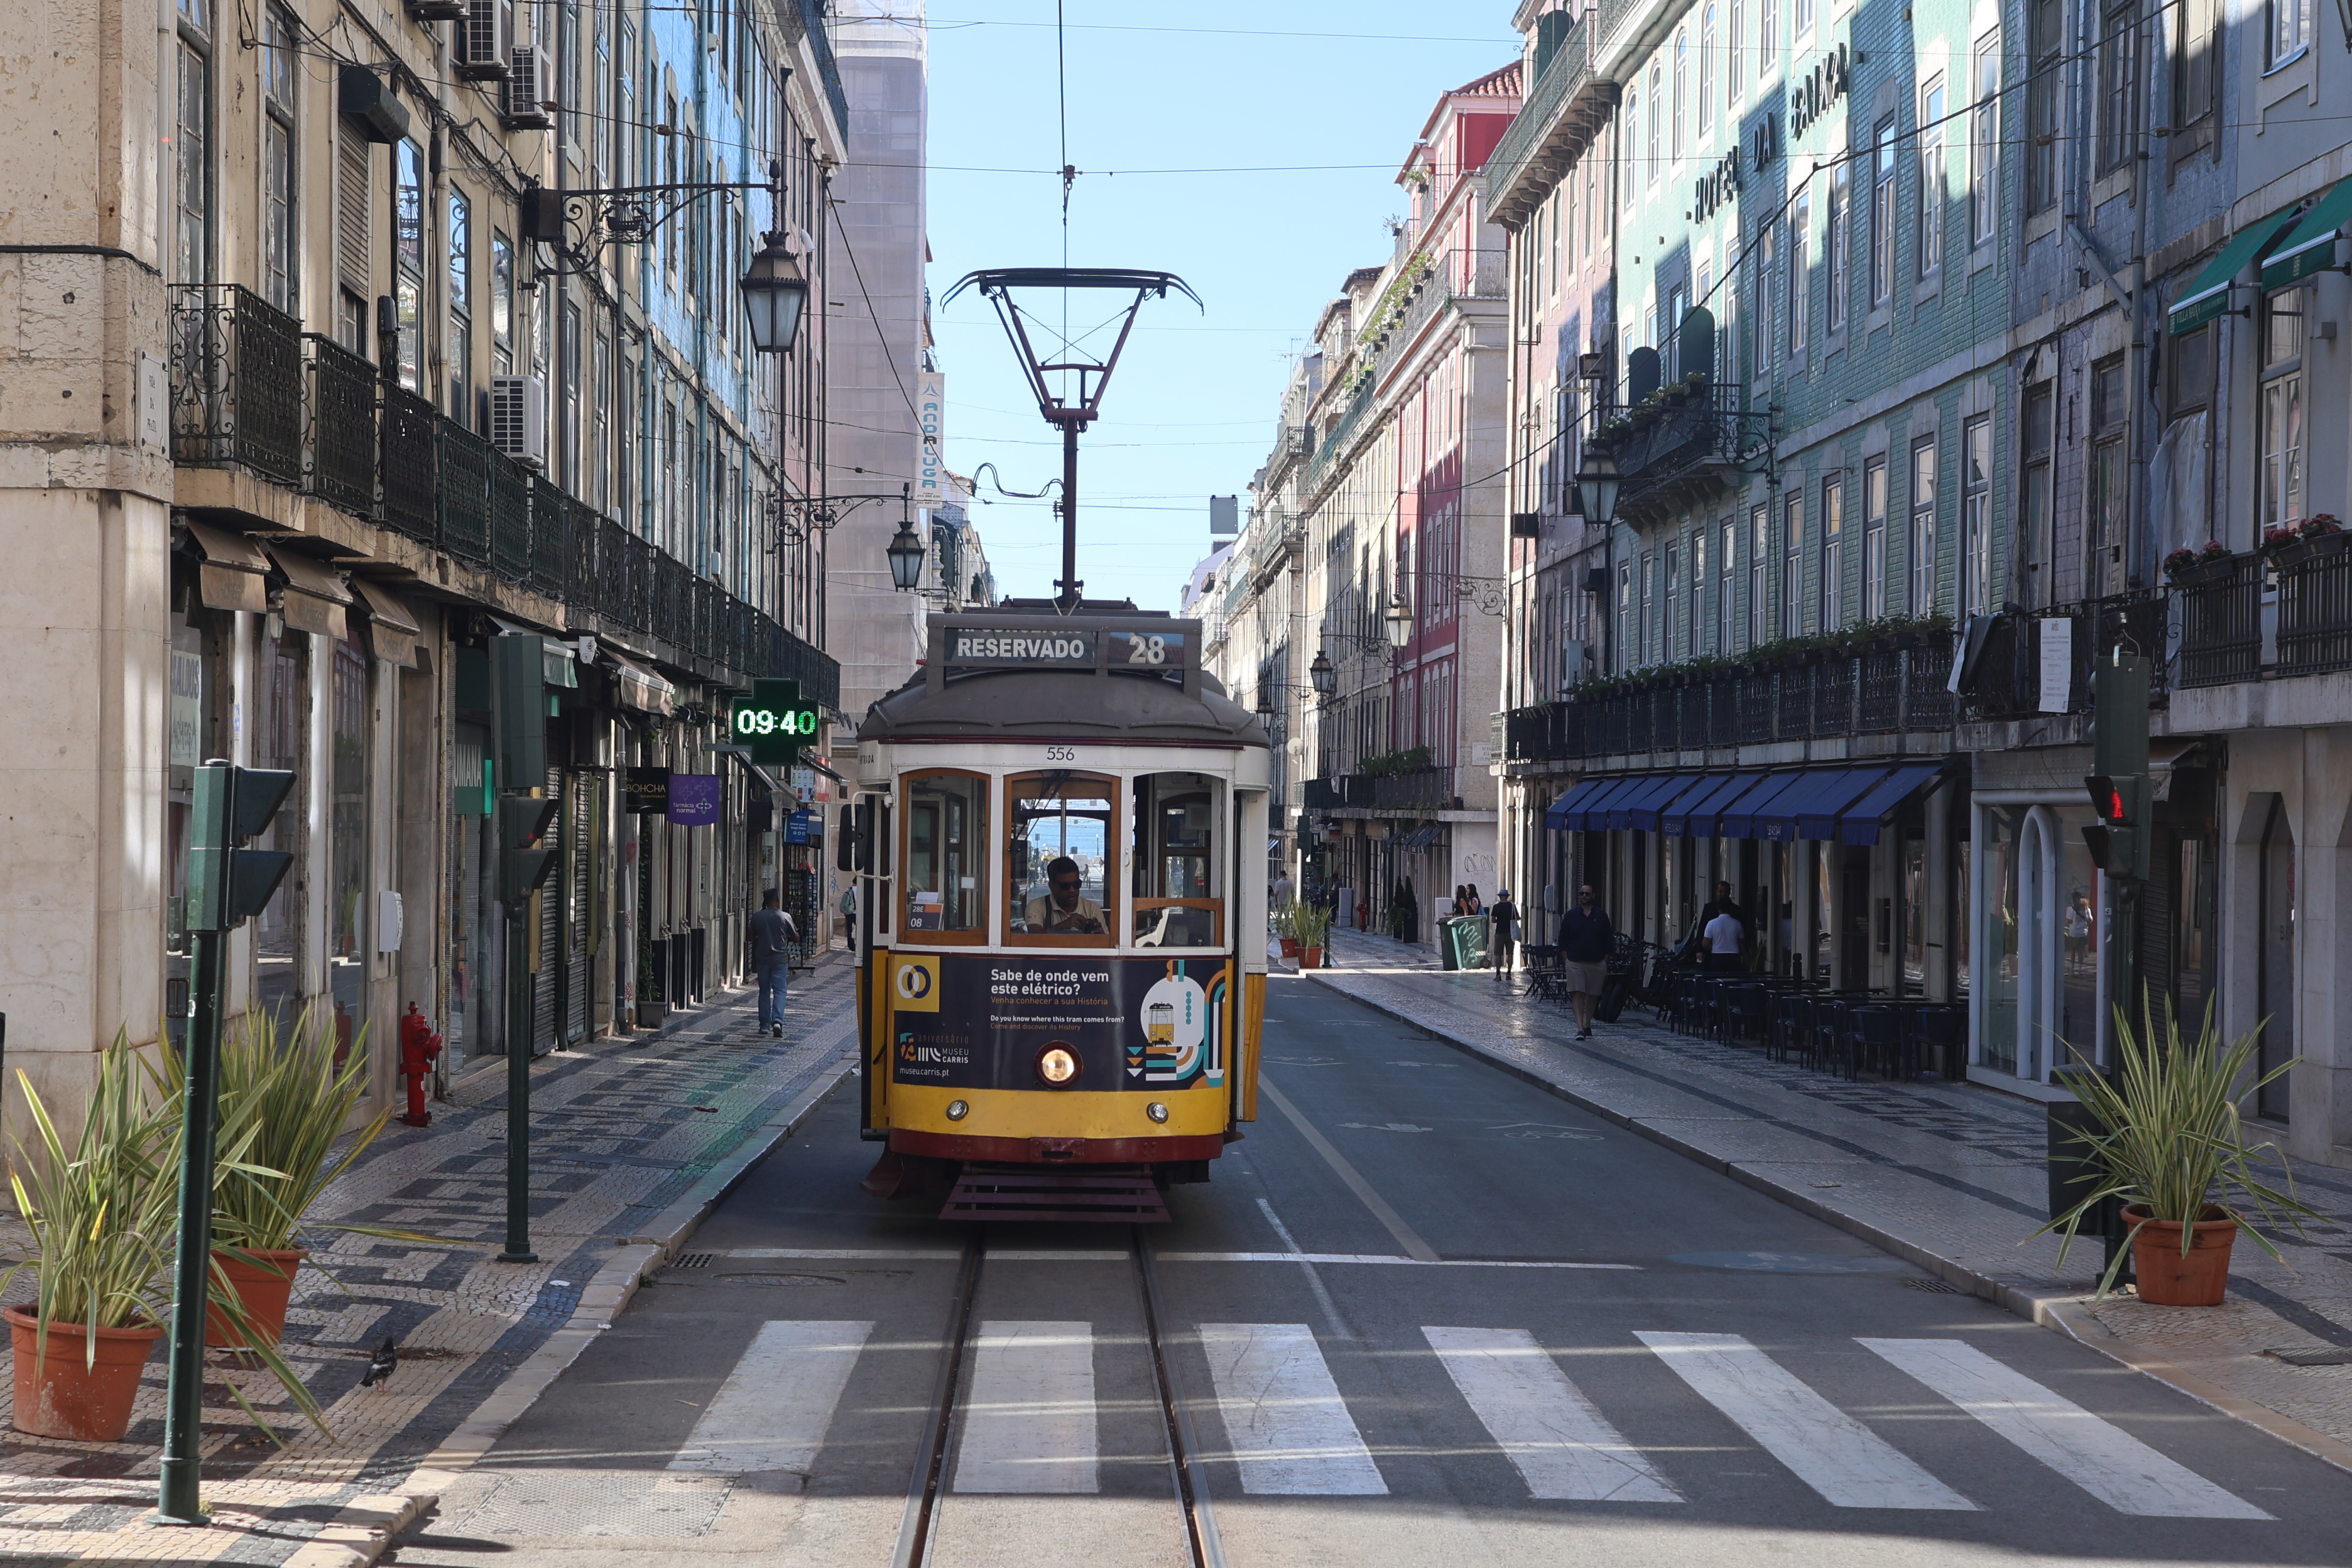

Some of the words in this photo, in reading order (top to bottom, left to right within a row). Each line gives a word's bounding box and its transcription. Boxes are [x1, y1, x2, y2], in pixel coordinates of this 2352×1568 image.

[1695, 145, 1743, 224] HOTEL
[1753, 112, 1775, 172] DA
[1791, 42, 1848, 139] BAIXA
[150, 397, 155, 410] DA
[922, 402, 938, 489] ANDALUGA
[957, 638, 1084, 658] RESERVADO
[1128, 634, 1165, 665] 28
[172, 655, 200, 700] SALDOS
[738, 709, 815, 735] 09:40
[1047, 746, 1075, 761] 556
[454, 743, 482, 788] UMANA
[626, 783, 666, 793] BOHCHA
[910, 918, 922, 927] 08
[991, 969, 1023, 981] Sabe
[1026, 969, 1042, 981] de
[1046, 970, 1078, 982] onde
[1081, 973, 1109, 982] vem
[991, 984, 1018, 994] este
[1021, 983, 1081, 995] elétrico?
[991, 996, 1014, 1004] Venha
[1077, 997, 1108, 1005] História
[918, 1033, 969, 1044] aniversário
[900, 1067, 949, 1078] museu.carris.pt
